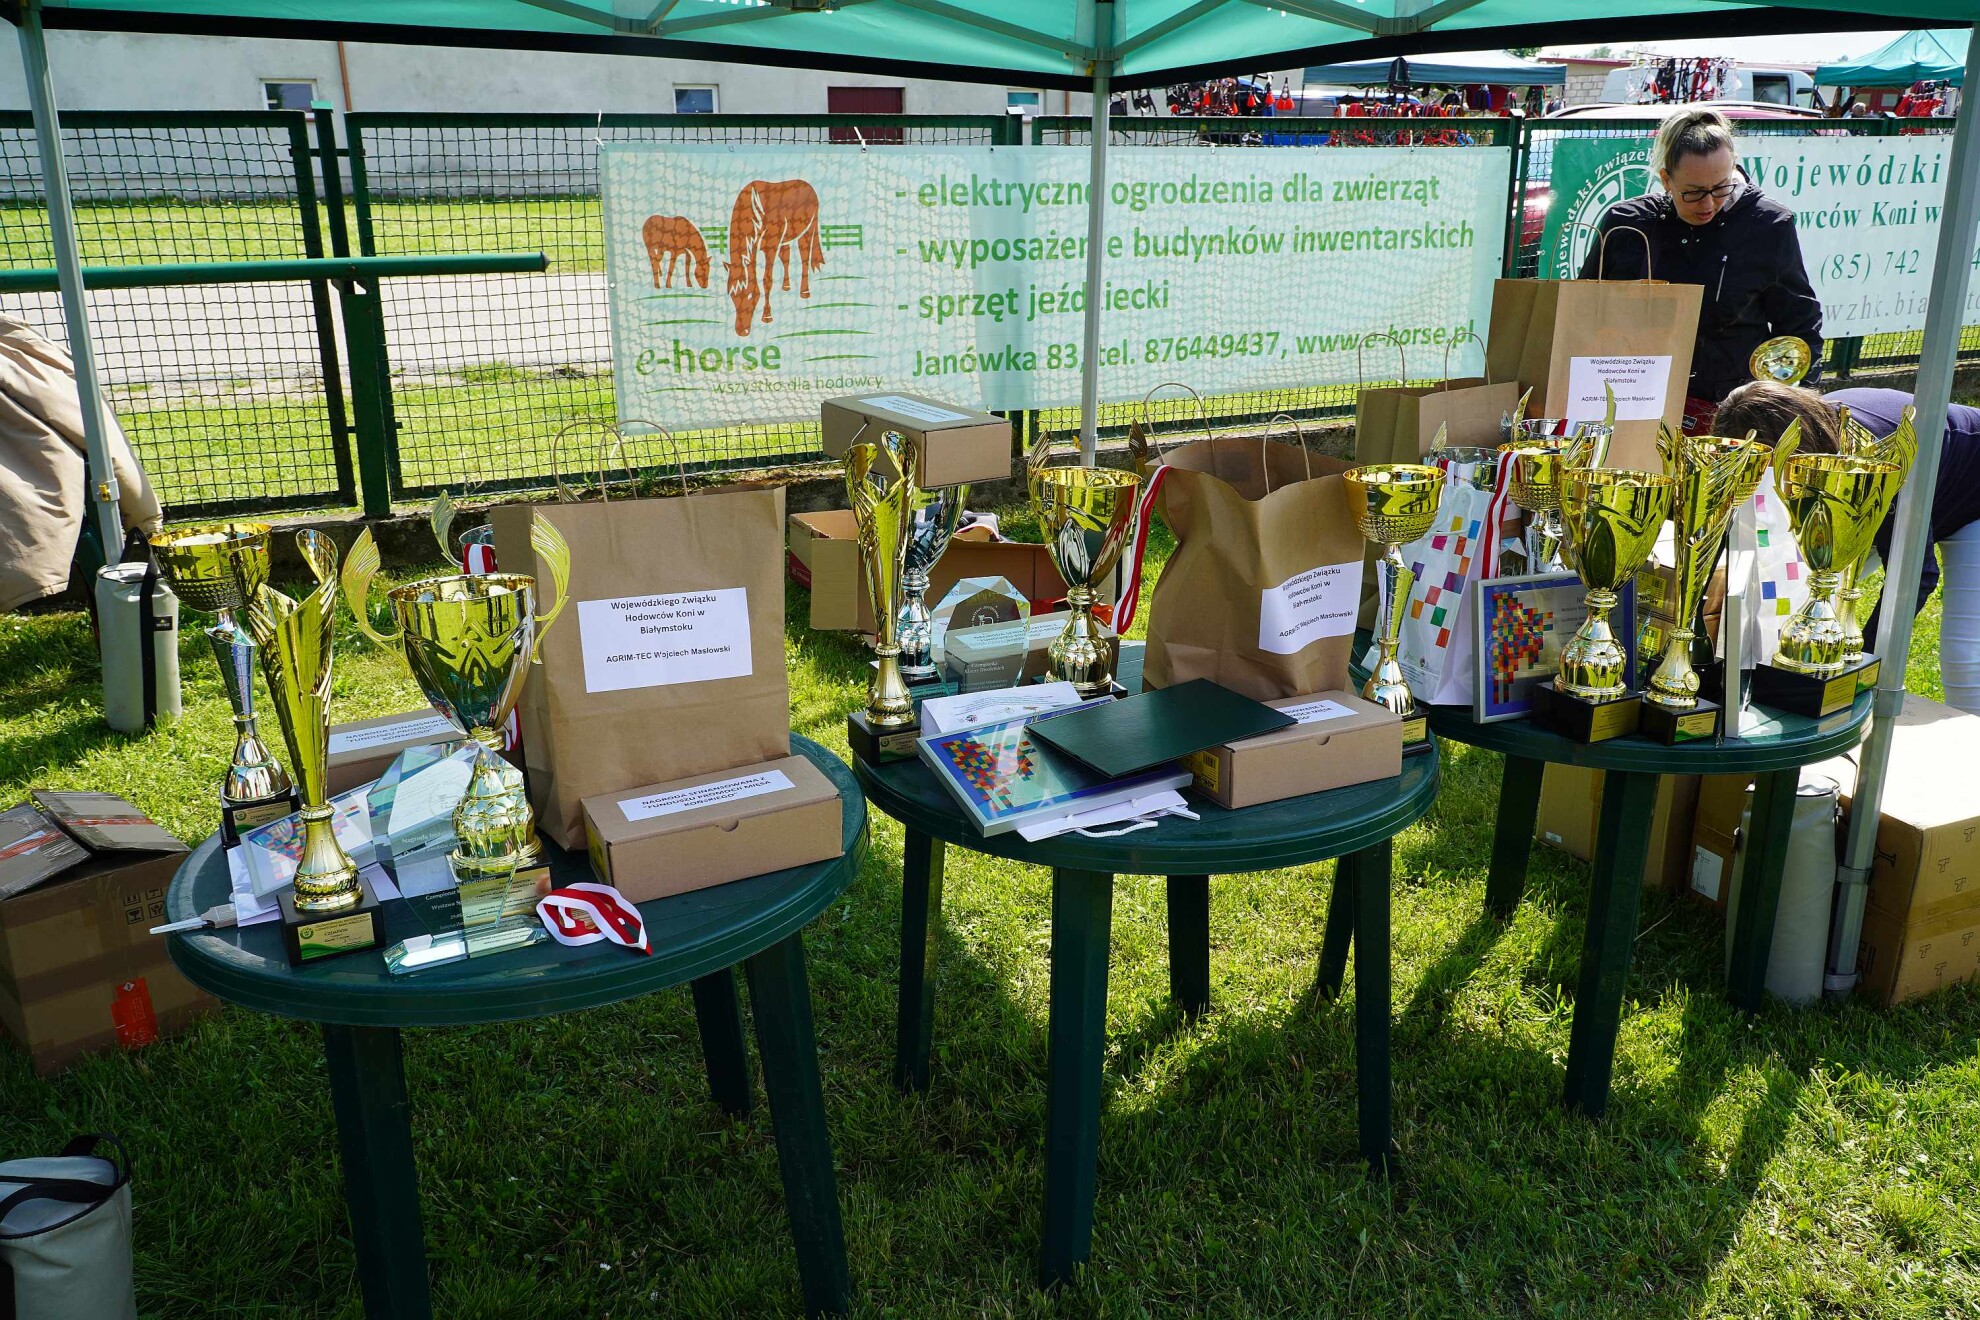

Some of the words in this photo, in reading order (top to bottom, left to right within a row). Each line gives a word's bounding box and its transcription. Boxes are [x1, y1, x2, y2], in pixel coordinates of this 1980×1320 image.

[1111, 173, 1273, 212] ogrodzenia
[1283, 173, 1323, 203] dla
[1332, 173, 1440, 207] zwierząt
[1742, 154, 1942, 197] Wojewódzki
[1556, 179, 1594, 280] ojewódzki
[1870, 200, 1918, 227] Koni
[918, 230, 1123, 269] wyposażene
[1133, 225, 1284, 263] budynków
[1293, 220, 1473, 252] inwentarskich
[1820, 252, 1871, 287] (85)
[1883, 250, 1920, 276] 742
[919, 288, 1019, 325] sprzęt
[1027, 279, 1169, 321] jeźdiecki
[636, 339, 782, 376] e-horse
[913, 344, 1038, 376] Janówka
[1098, 339, 1136, 367] tel.
[1144, 331, 1288, 364] 876449437,
[713, 378, 782, 395] wszystko
[788, 377, 810, 391] dla
[816, 375, 883, 388] hodowcy
[610, 597, 680, 611] Wojewódzkiego
[681, 594, 717, 605] Związku
[625, 610, 674, 622] Hodowców
[676, 609, 695, 618] Koni
[640, 623, 693, 635] Białymstoku
[606, 652, 652, 663] AGRIM-TEC
[654, 649, 689, 660] Wojciech
[691, 645, 731, 655] Masłowski
